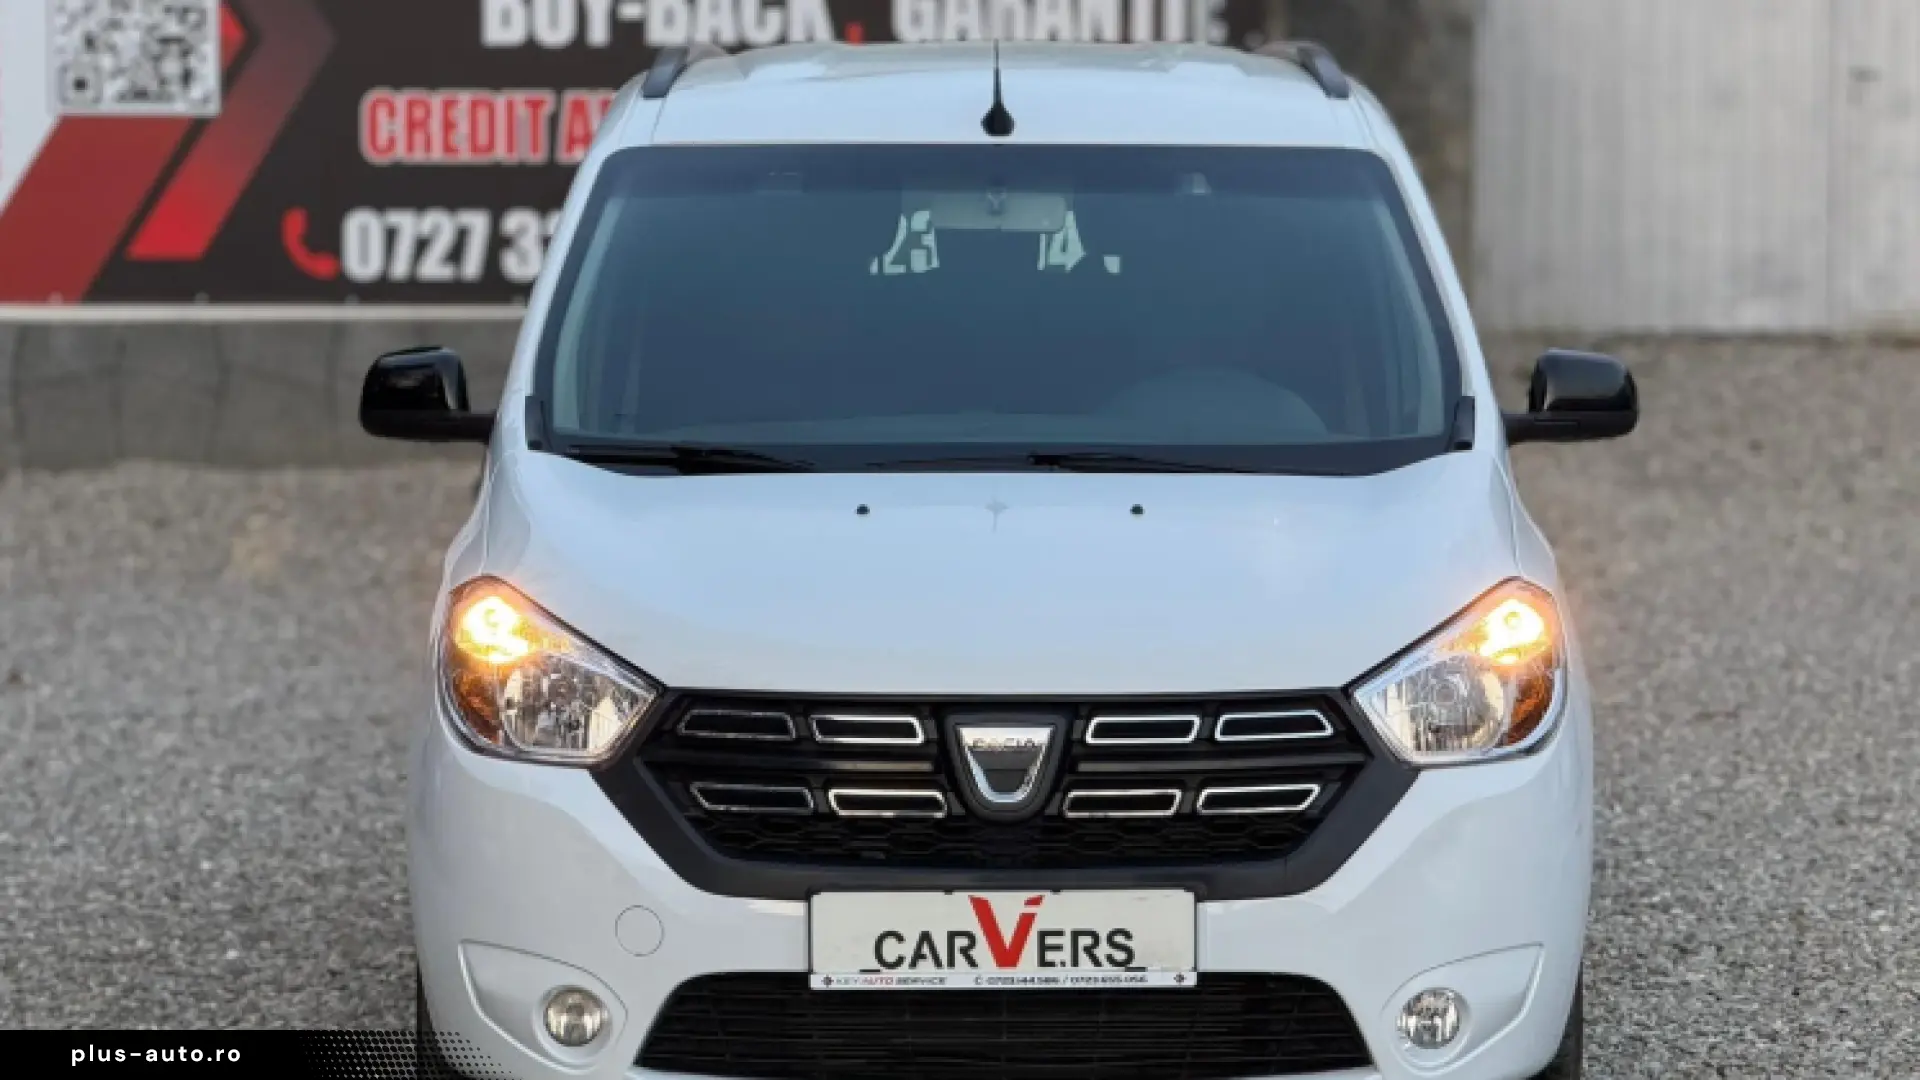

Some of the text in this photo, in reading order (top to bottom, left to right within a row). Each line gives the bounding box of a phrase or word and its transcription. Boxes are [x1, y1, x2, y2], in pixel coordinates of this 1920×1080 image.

[360, 88, 618, 165] CREDIT A
[341, 207, 563, 283] 0727 3
[861, 975, 894, 986] AUTO
[896, 975, 947, 986] SERVICE
